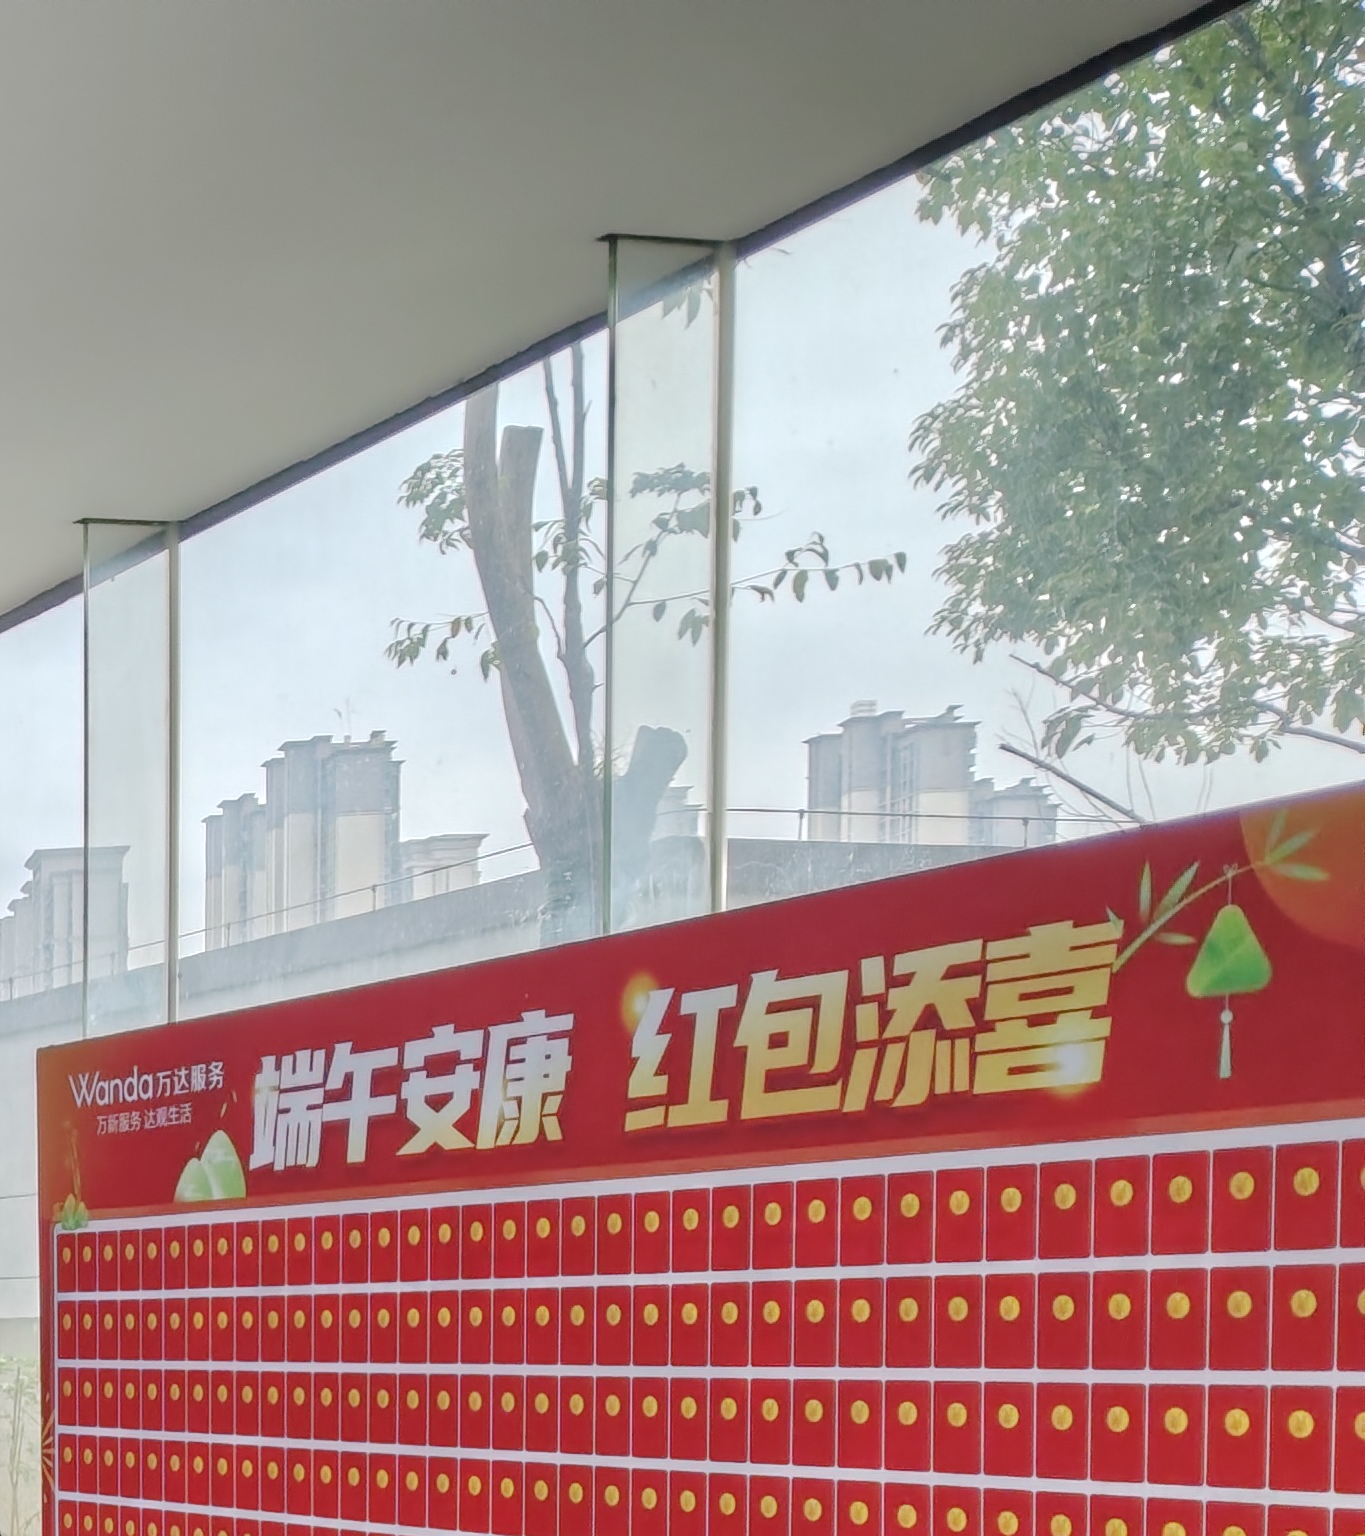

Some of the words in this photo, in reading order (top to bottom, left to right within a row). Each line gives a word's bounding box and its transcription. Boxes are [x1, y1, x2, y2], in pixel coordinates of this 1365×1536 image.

[69, 1065, 153, 1108] Wanda
[156, 1061, 224, 1098] 万达服务
[249, 1009, 574, 1172] 端午安康
[624, 919, 1124, 1132] 红包添喜
